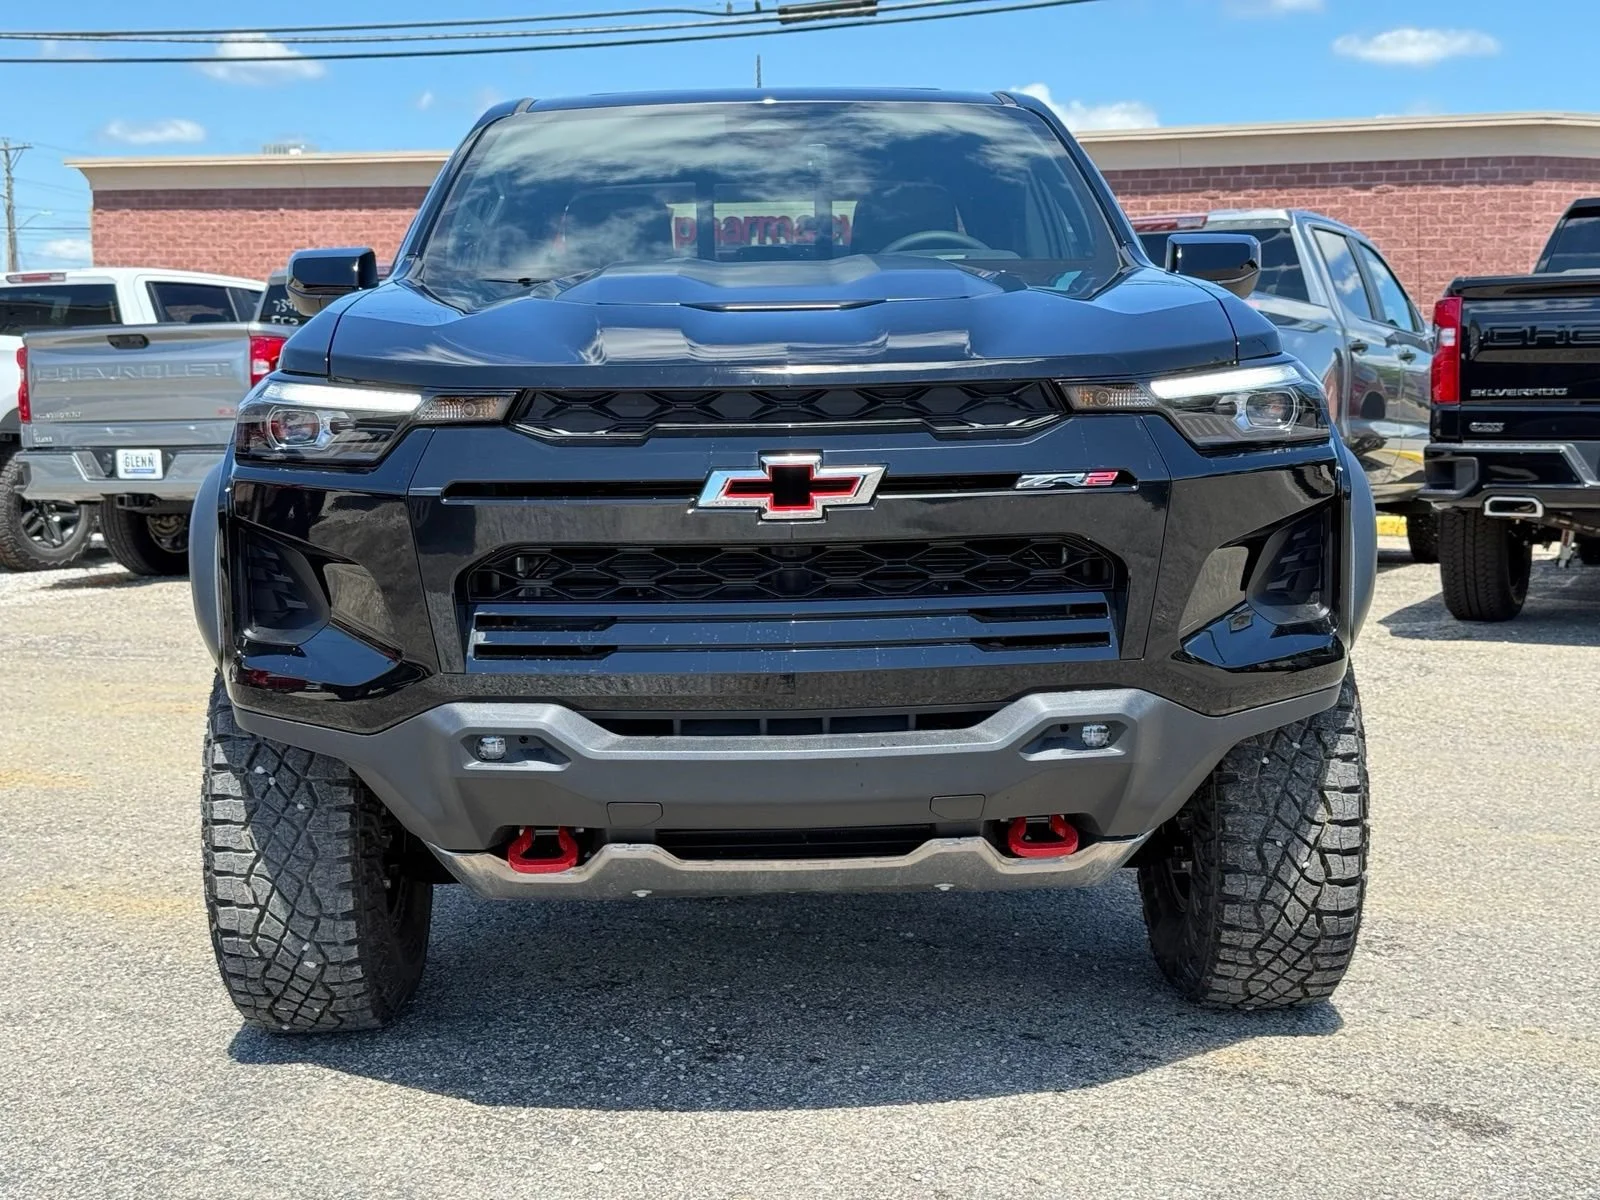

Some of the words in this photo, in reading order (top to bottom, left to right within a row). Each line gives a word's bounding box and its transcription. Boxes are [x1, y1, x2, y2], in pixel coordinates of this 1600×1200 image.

[674, 215, 853, 248] parma
[32, 363, 231, 382] CHEVROLET
[1470, 388, 1568, 397] SILVERADO
[125, 456, 154, 467] GLENN
[1015, 471, 1119, 489] ZR2
